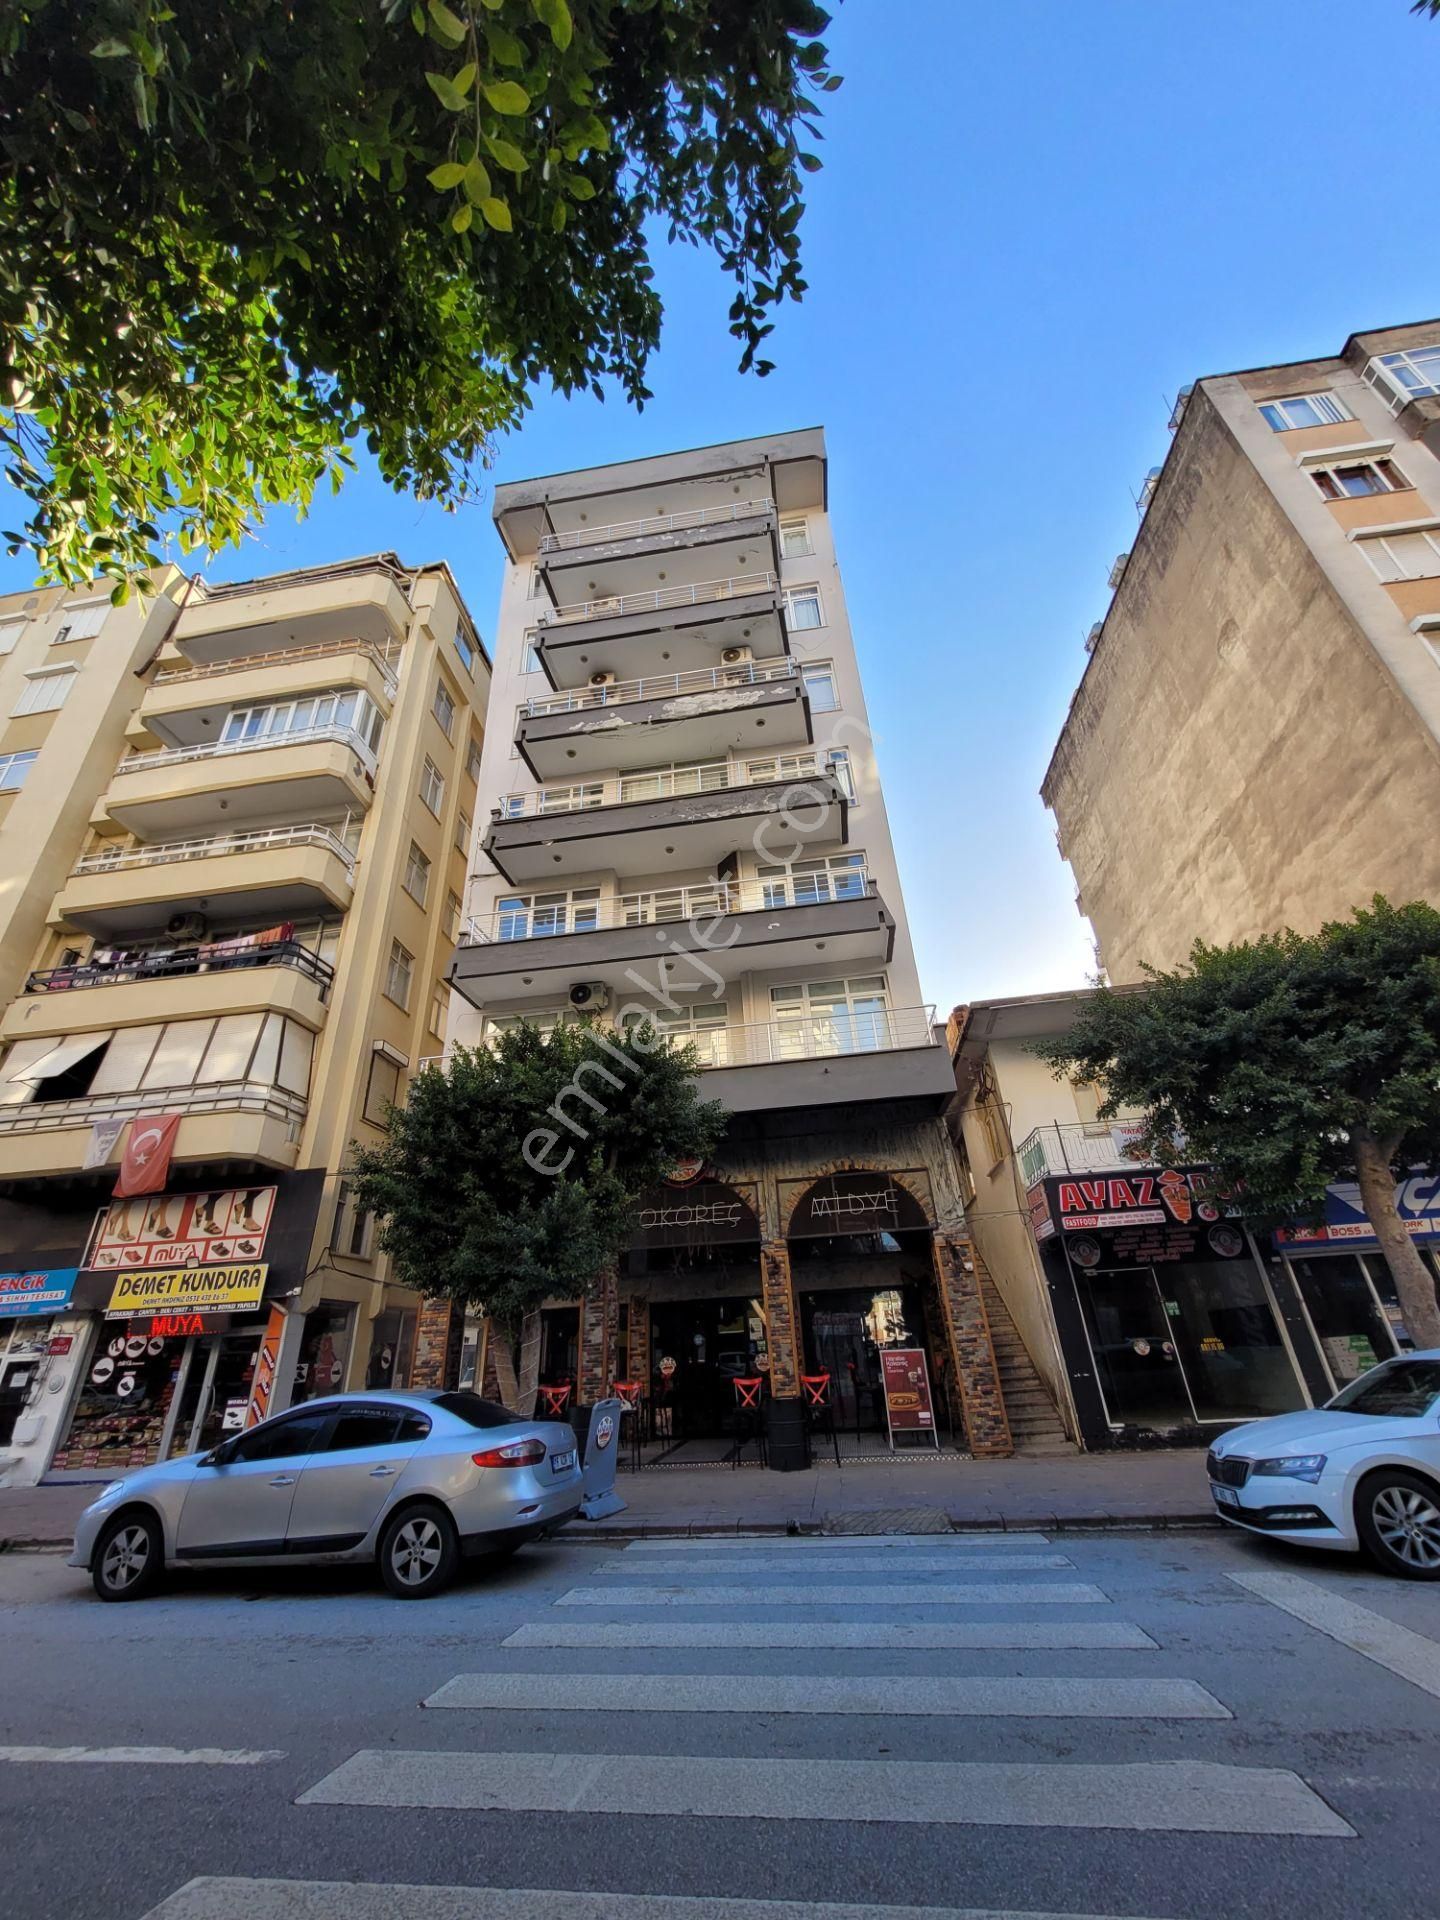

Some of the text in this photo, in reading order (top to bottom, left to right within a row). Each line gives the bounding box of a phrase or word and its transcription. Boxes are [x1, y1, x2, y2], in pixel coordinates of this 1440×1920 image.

[1059, 1177, 1160, 1212] AYAZ
[638, 1202, 742, 1228] OKOREÇ
[1065, 1217, 1097, 1227] FASTFOOD
[1403, 1220, 1424, 1228] ORK
[1331, 1227, 1362, 1237] BOSS
[0, 1273, 49, 1291] ENCİK
[118, 1268, 261, 1296] DEMET KUNDURA
[151, 1313, 204, 1337] MUYA
